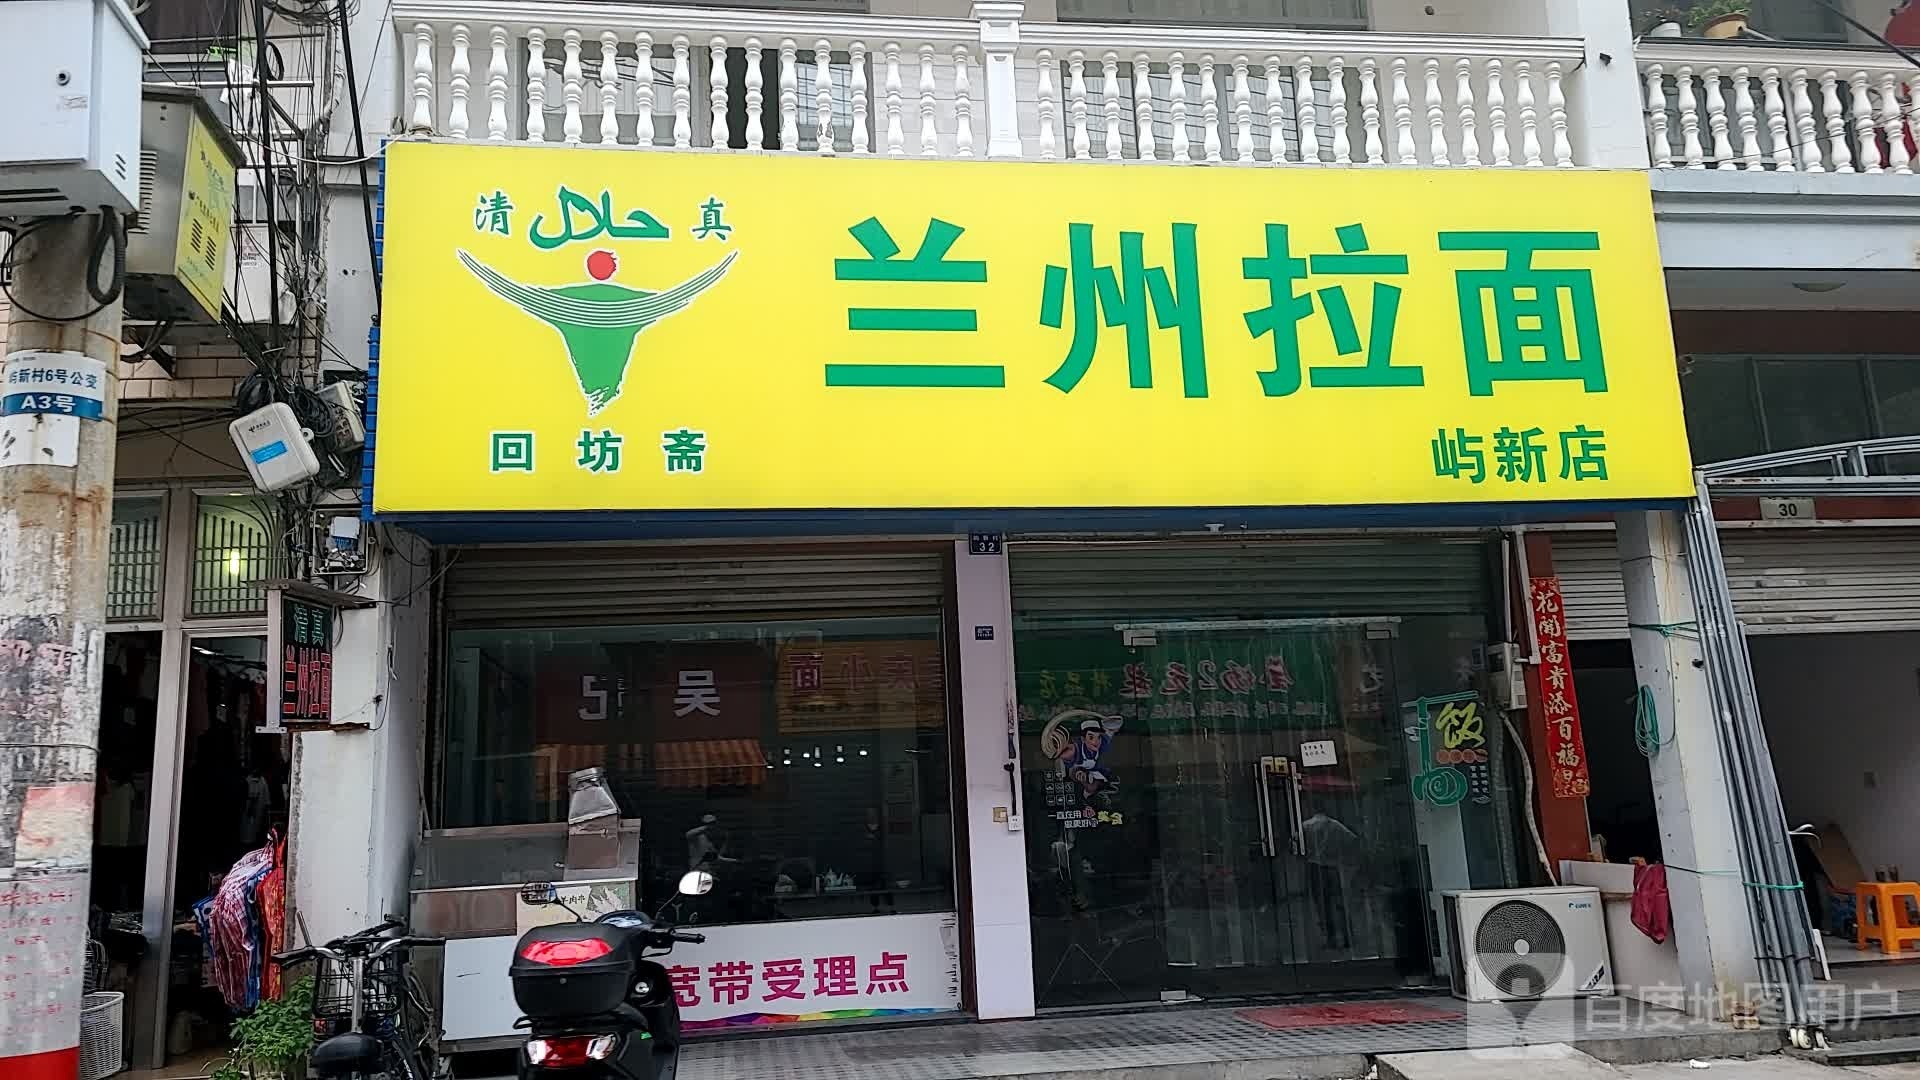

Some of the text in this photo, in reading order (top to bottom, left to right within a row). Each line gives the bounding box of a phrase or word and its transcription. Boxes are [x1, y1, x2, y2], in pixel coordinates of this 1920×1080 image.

[475, 191, 514, 235] 清
[692, 197, 733, 241] 真
[824, 216, 1609, 399] 兰州拉面
[20, 395, 76, 413] A3号
[491, 429, 707, 472] 回坊斋
[1431, 424, 1609, 484] 屿新店
[1778, 503, 1798, 517] 30
[979, 542, 995, 552] 32
[293, 602, 325, 648] 清真
[282, 643, 332, 718] 兰州拉面
[666, 951, 910, 1008] 宽带受理点
